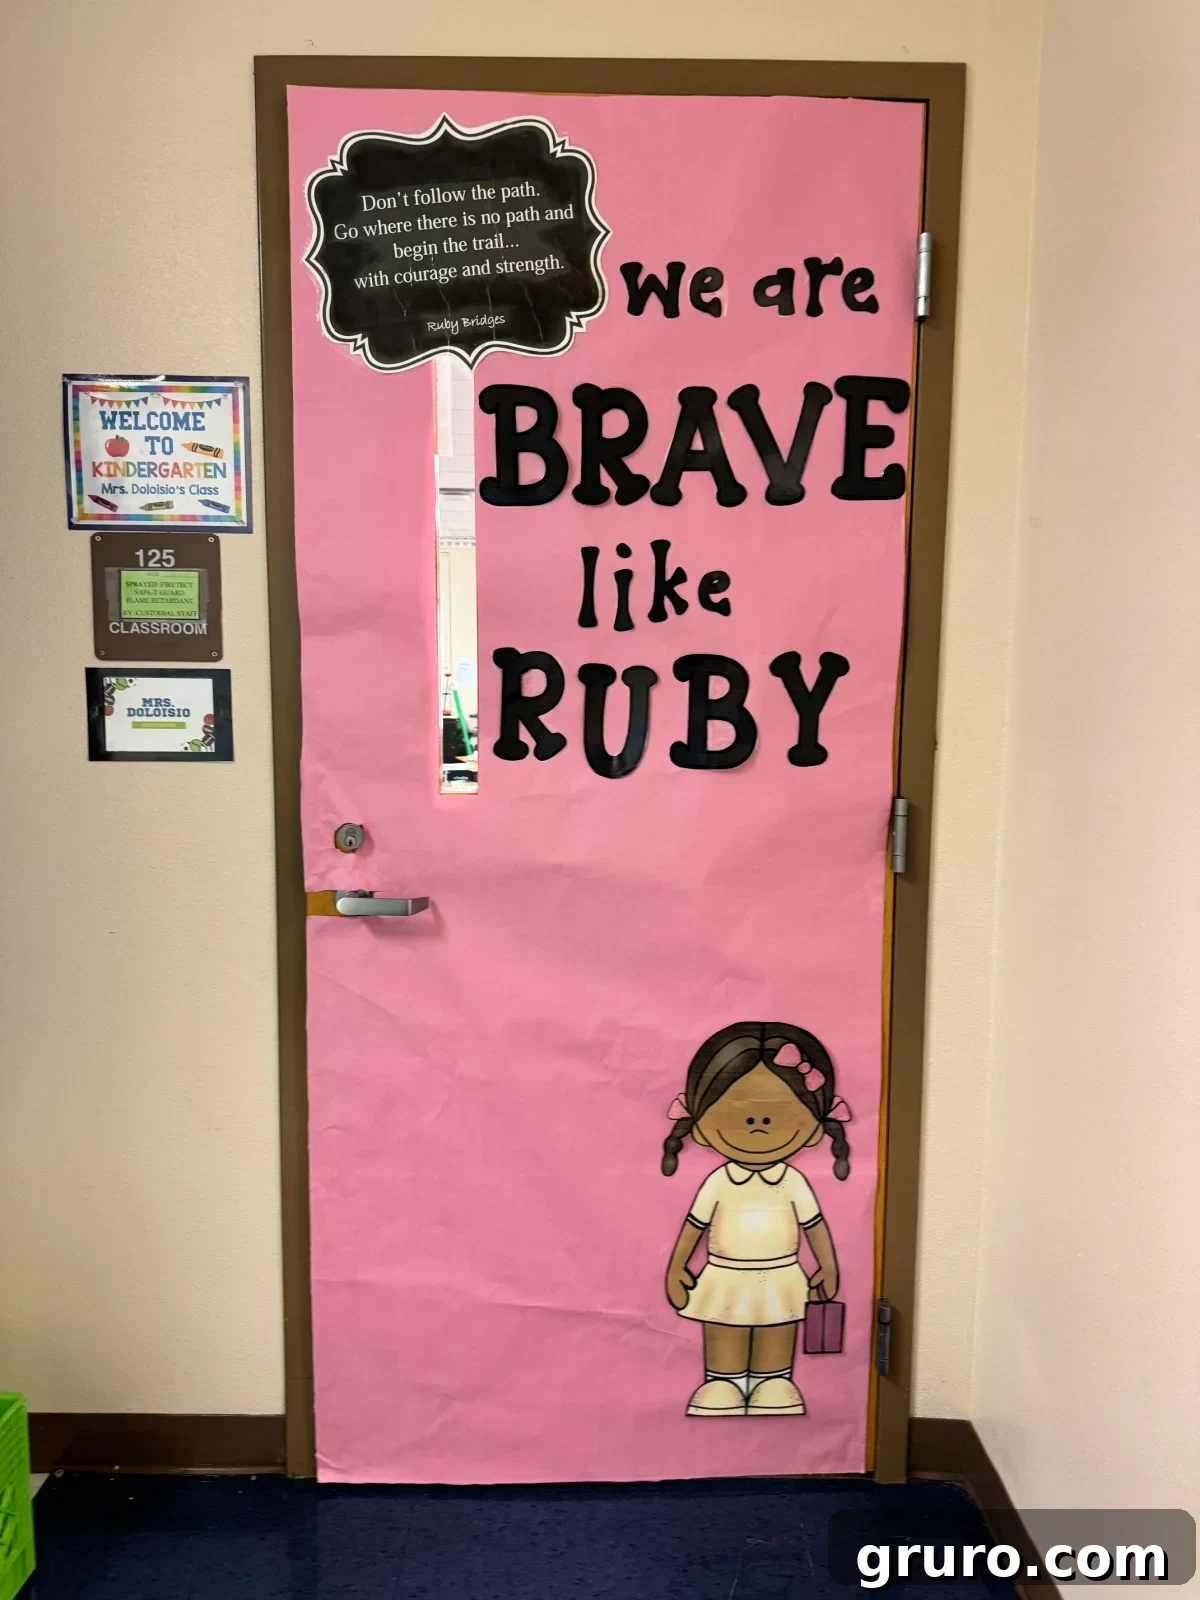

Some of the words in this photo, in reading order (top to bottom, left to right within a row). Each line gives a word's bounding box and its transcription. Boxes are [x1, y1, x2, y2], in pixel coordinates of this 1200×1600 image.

[361, 191, 409, 212] Don't
[414, 187, 466, 206] follow
[471, 184, 496, 201] the
[501, 182, 540, 202] path.
[334, 224, 358, 240] Go
[363, 218, 412, 237] where
[417, 214, 457, 231] there
[463, 212, 476, 227] is
[481, 211, 500, 224] no
[506, 207, 540, 227] path
[545, 204, 574, 220] and
[393, 239, 438, 262] begin
[443, 237, 467, 253] the
[472, 233, 519, 250] trail...
[354, 272, 389, 289] with
[394, 264, 457, 284] courage
[462, 257, 491, 277] and
[495, 254, 564, 276] strength.
[620, 261, 725, 318] we
[753, 256, 879, 317] are
[427, 320, 459, 334] Ruby
[462, 314, 506, 328] Bridges
[99, 411, 205, 431] WELCOME
[145, 436, 173, 455] TO
[478, 375, 911, 507] BRAVE
[92, 461, 227, 478] KINDERGARTEN
[101, 484, 128, 494] Mrs.
[132, 484, 185, 495] Doloisio's
[189, 485, 219, 495] Class
[135, 549, 175, 568] 125
[577, 539, 732, 632] like
[109, 622, 208, 635] CLASSROOM
[127, 708, 190, 717] DOLOISIO
[141, 698, 175, 707] MRS.
[492, 647, 850, 779] RUBY
